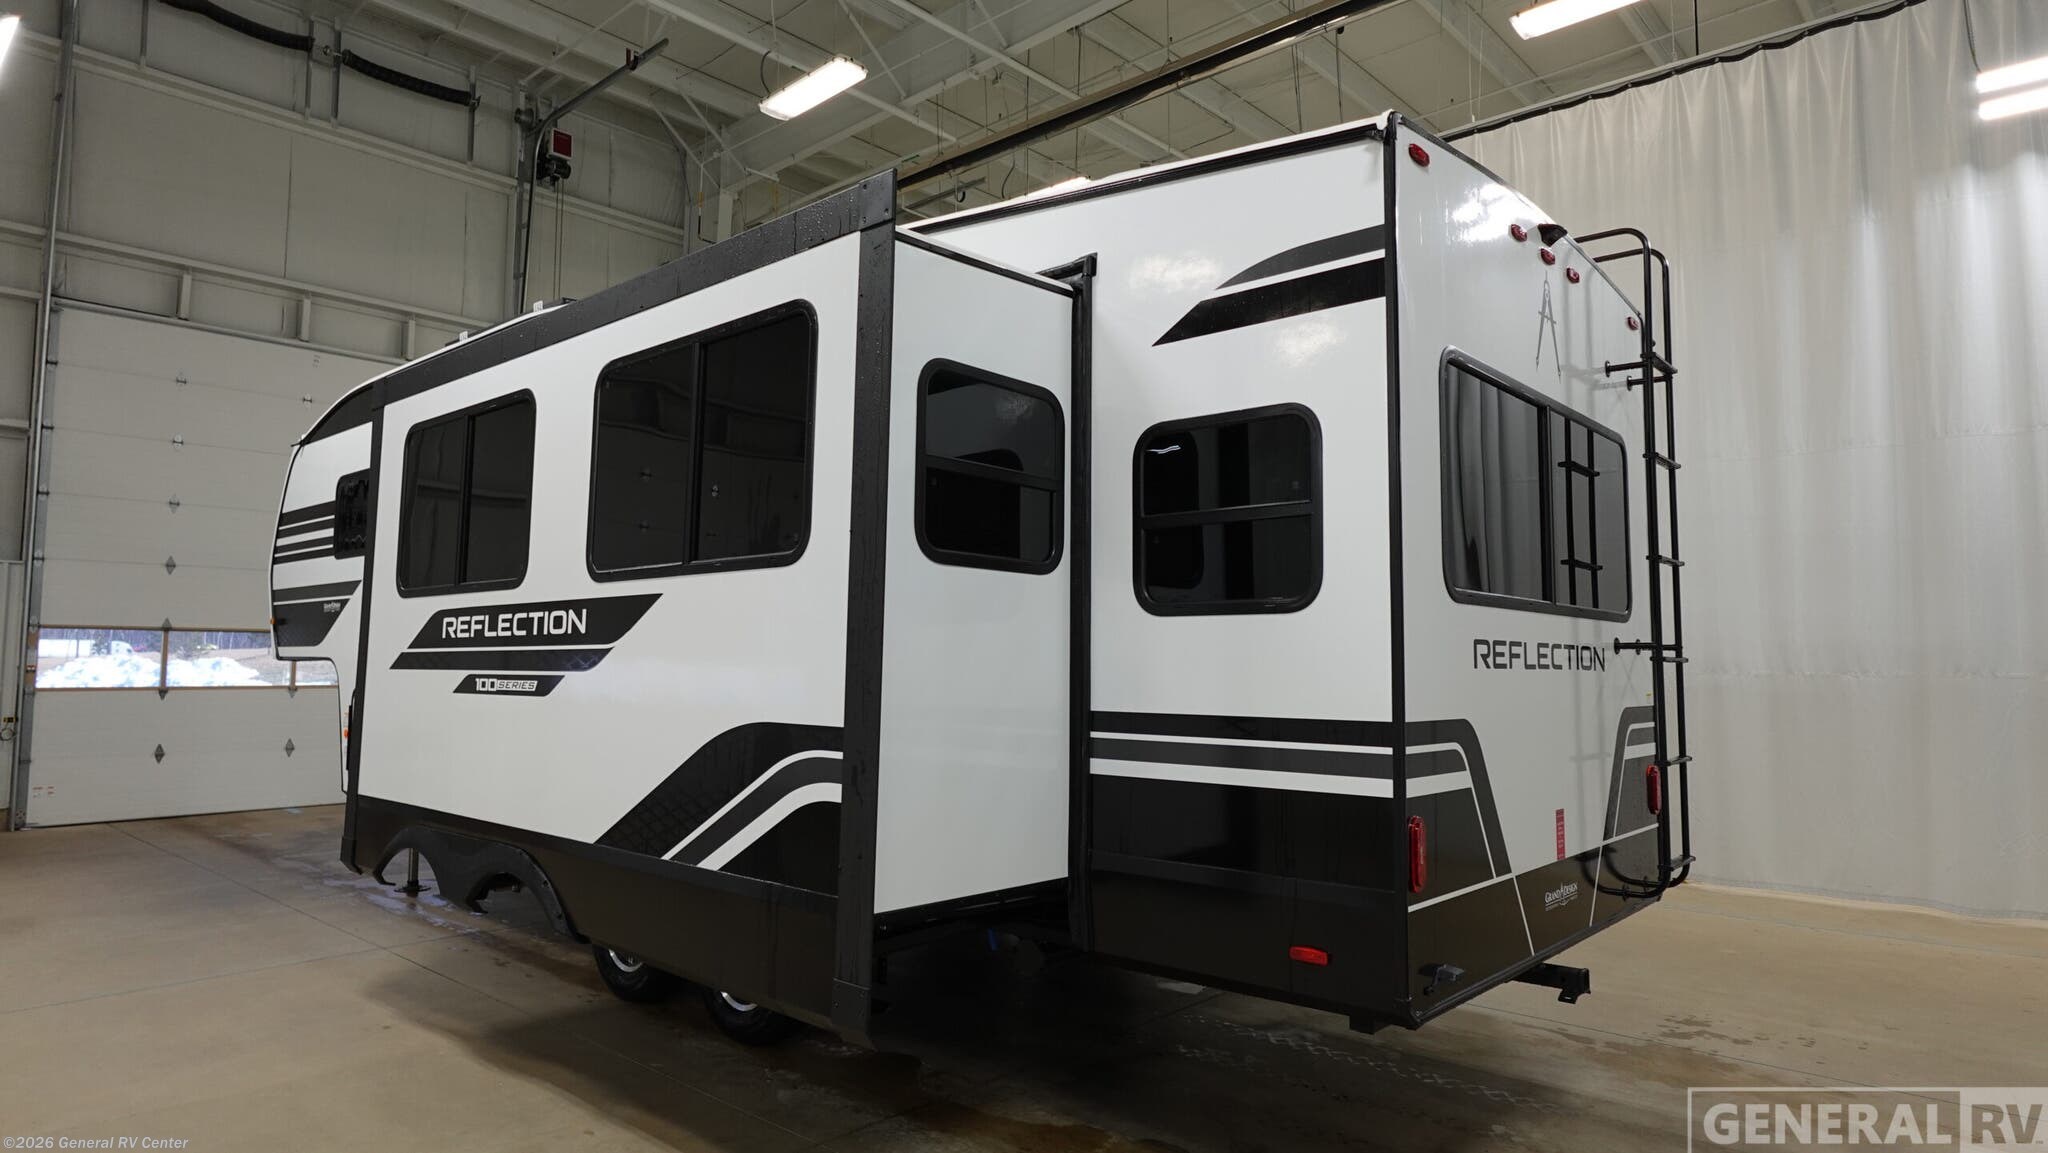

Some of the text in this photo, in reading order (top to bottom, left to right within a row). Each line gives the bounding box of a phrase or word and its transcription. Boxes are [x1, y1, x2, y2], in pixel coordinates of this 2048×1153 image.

[442, 608, 587, 639] REFLECTION
[1473, 638, 1605, 672] REFLECTION
[475, 678, 537, 692] 100 SERIES
